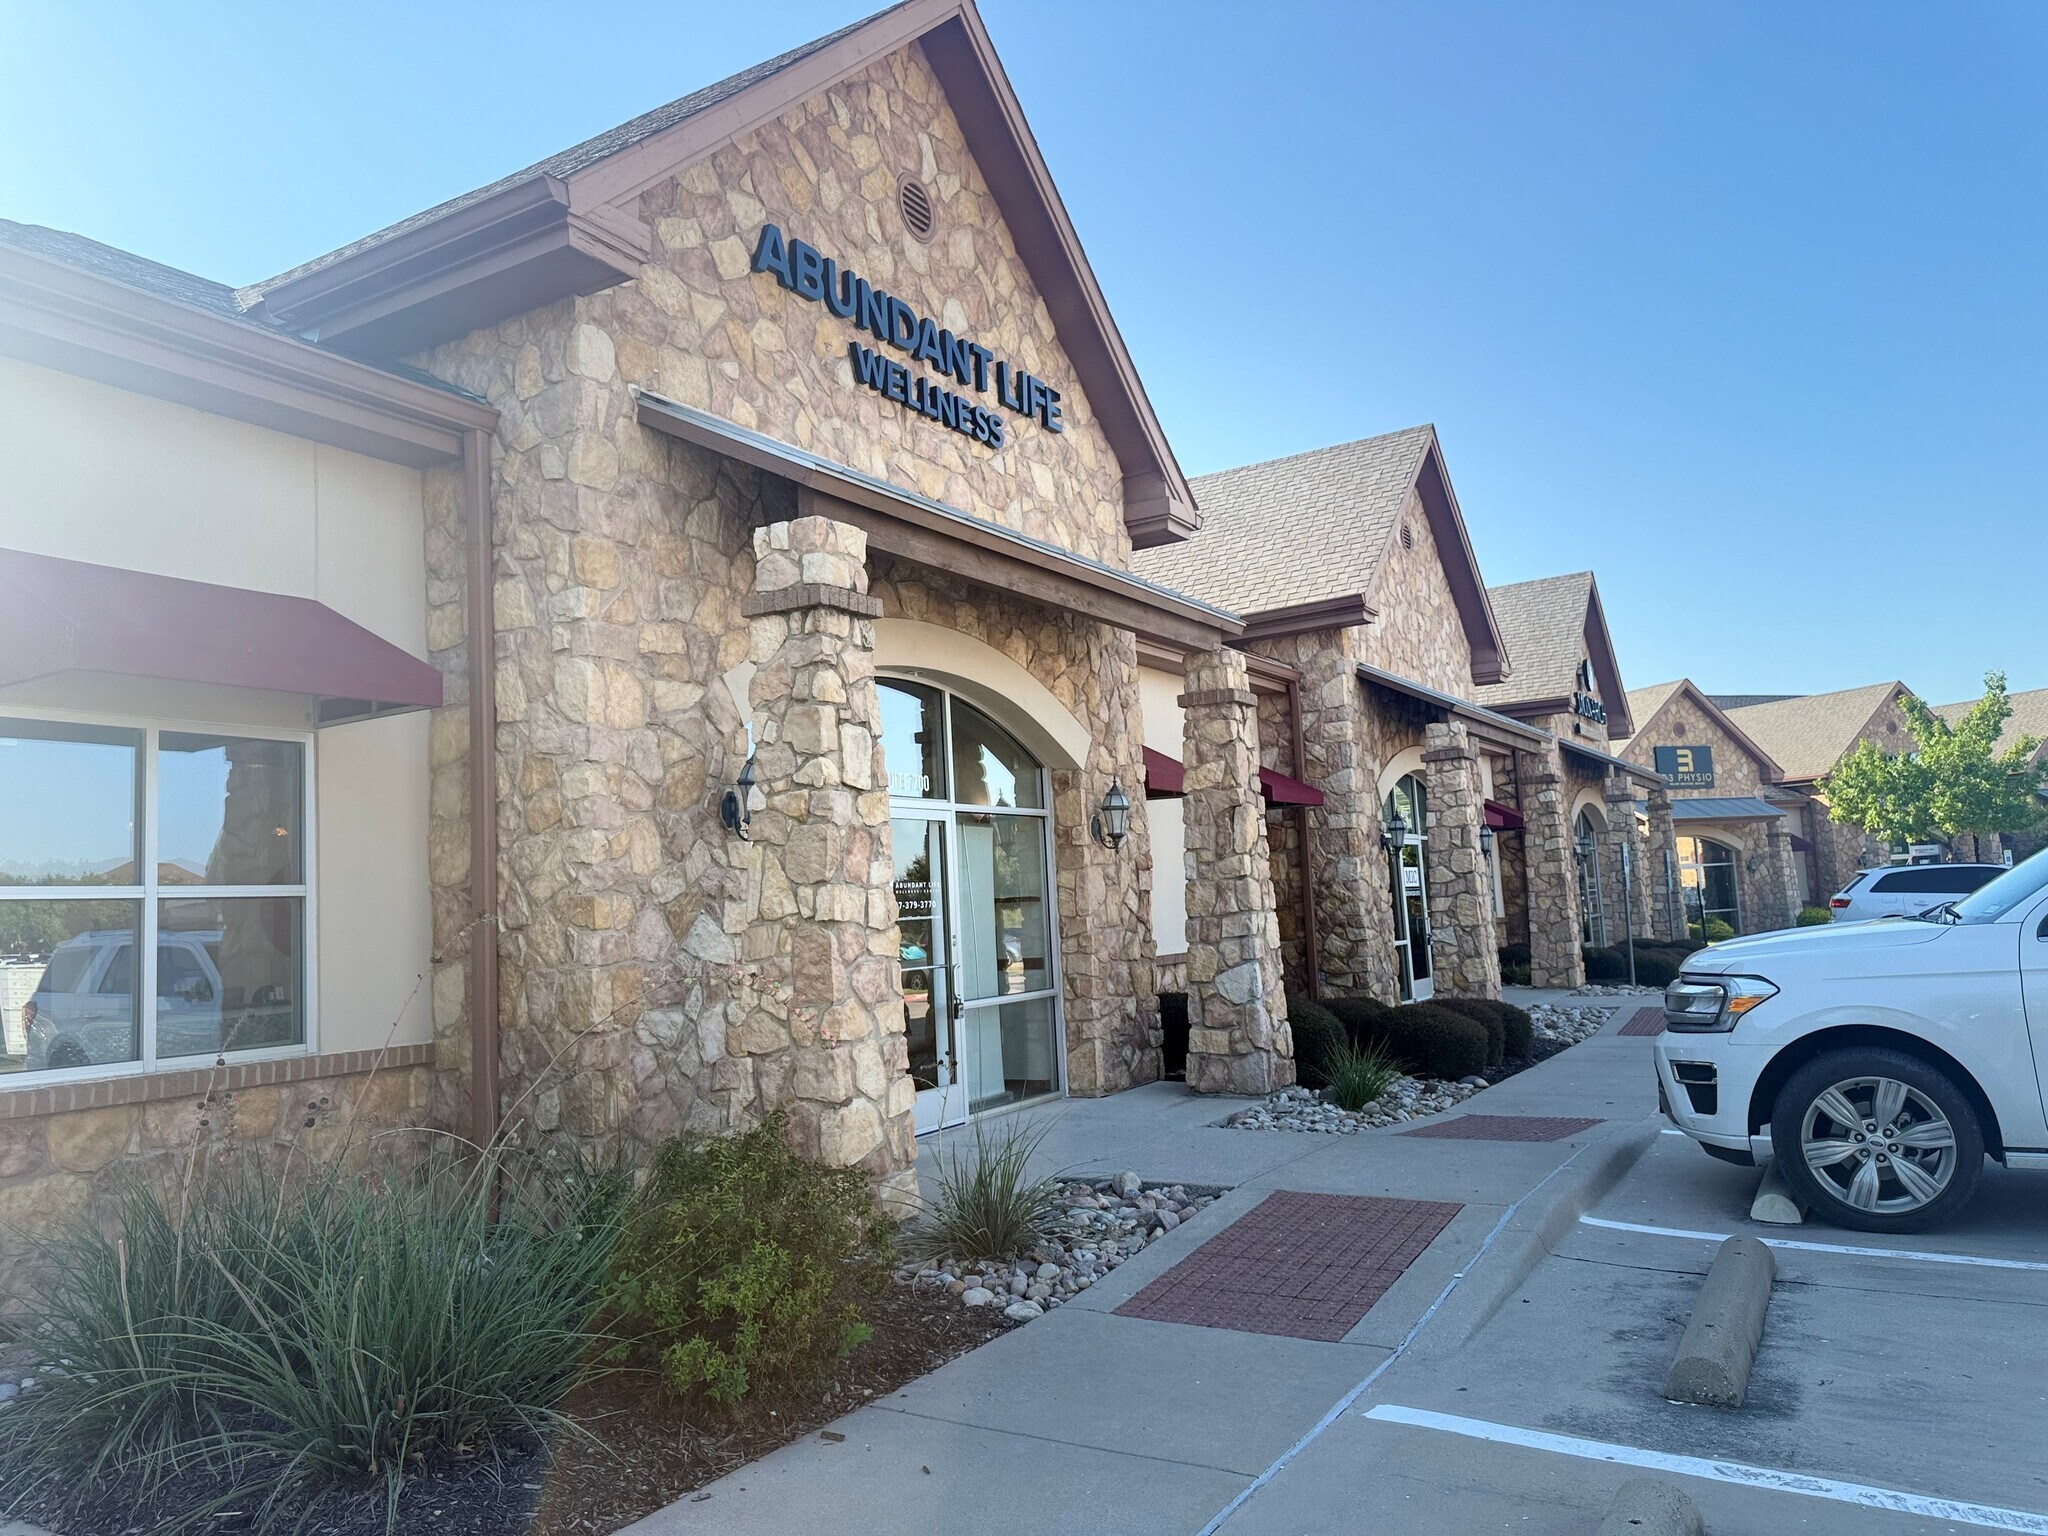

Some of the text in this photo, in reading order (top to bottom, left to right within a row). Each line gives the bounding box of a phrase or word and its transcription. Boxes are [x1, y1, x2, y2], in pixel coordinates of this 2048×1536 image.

[752, 223, 1063, 434] ABUNDANT LIFE
[849, 341, 1005, 450] WELLNESS
[1678, 773, 1713, 782] PHYSIO
[895, 881, 927, 889] ABUNDANT
[898, 900, 937, 910] 7-379-3770
